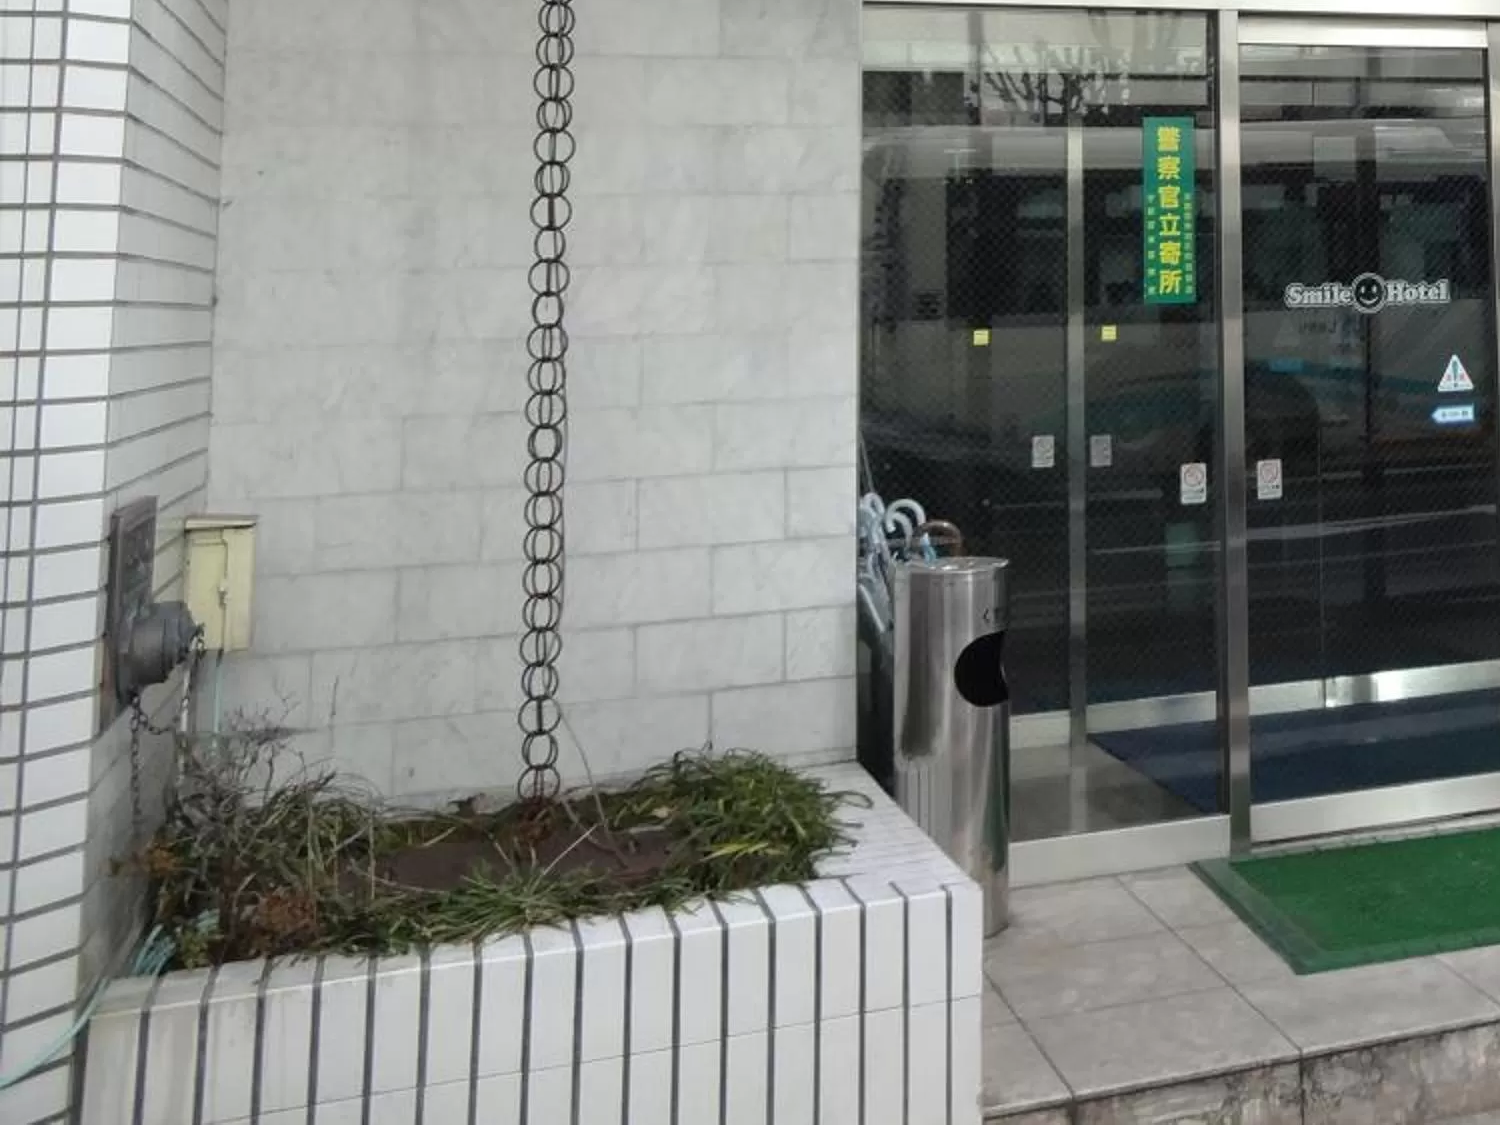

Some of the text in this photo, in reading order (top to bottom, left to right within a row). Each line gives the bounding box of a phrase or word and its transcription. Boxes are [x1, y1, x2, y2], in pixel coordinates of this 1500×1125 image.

[1157, 126, 1182, 296] 警察官立寄所
[1286, 281, 1449, 305] Smile Hotel
